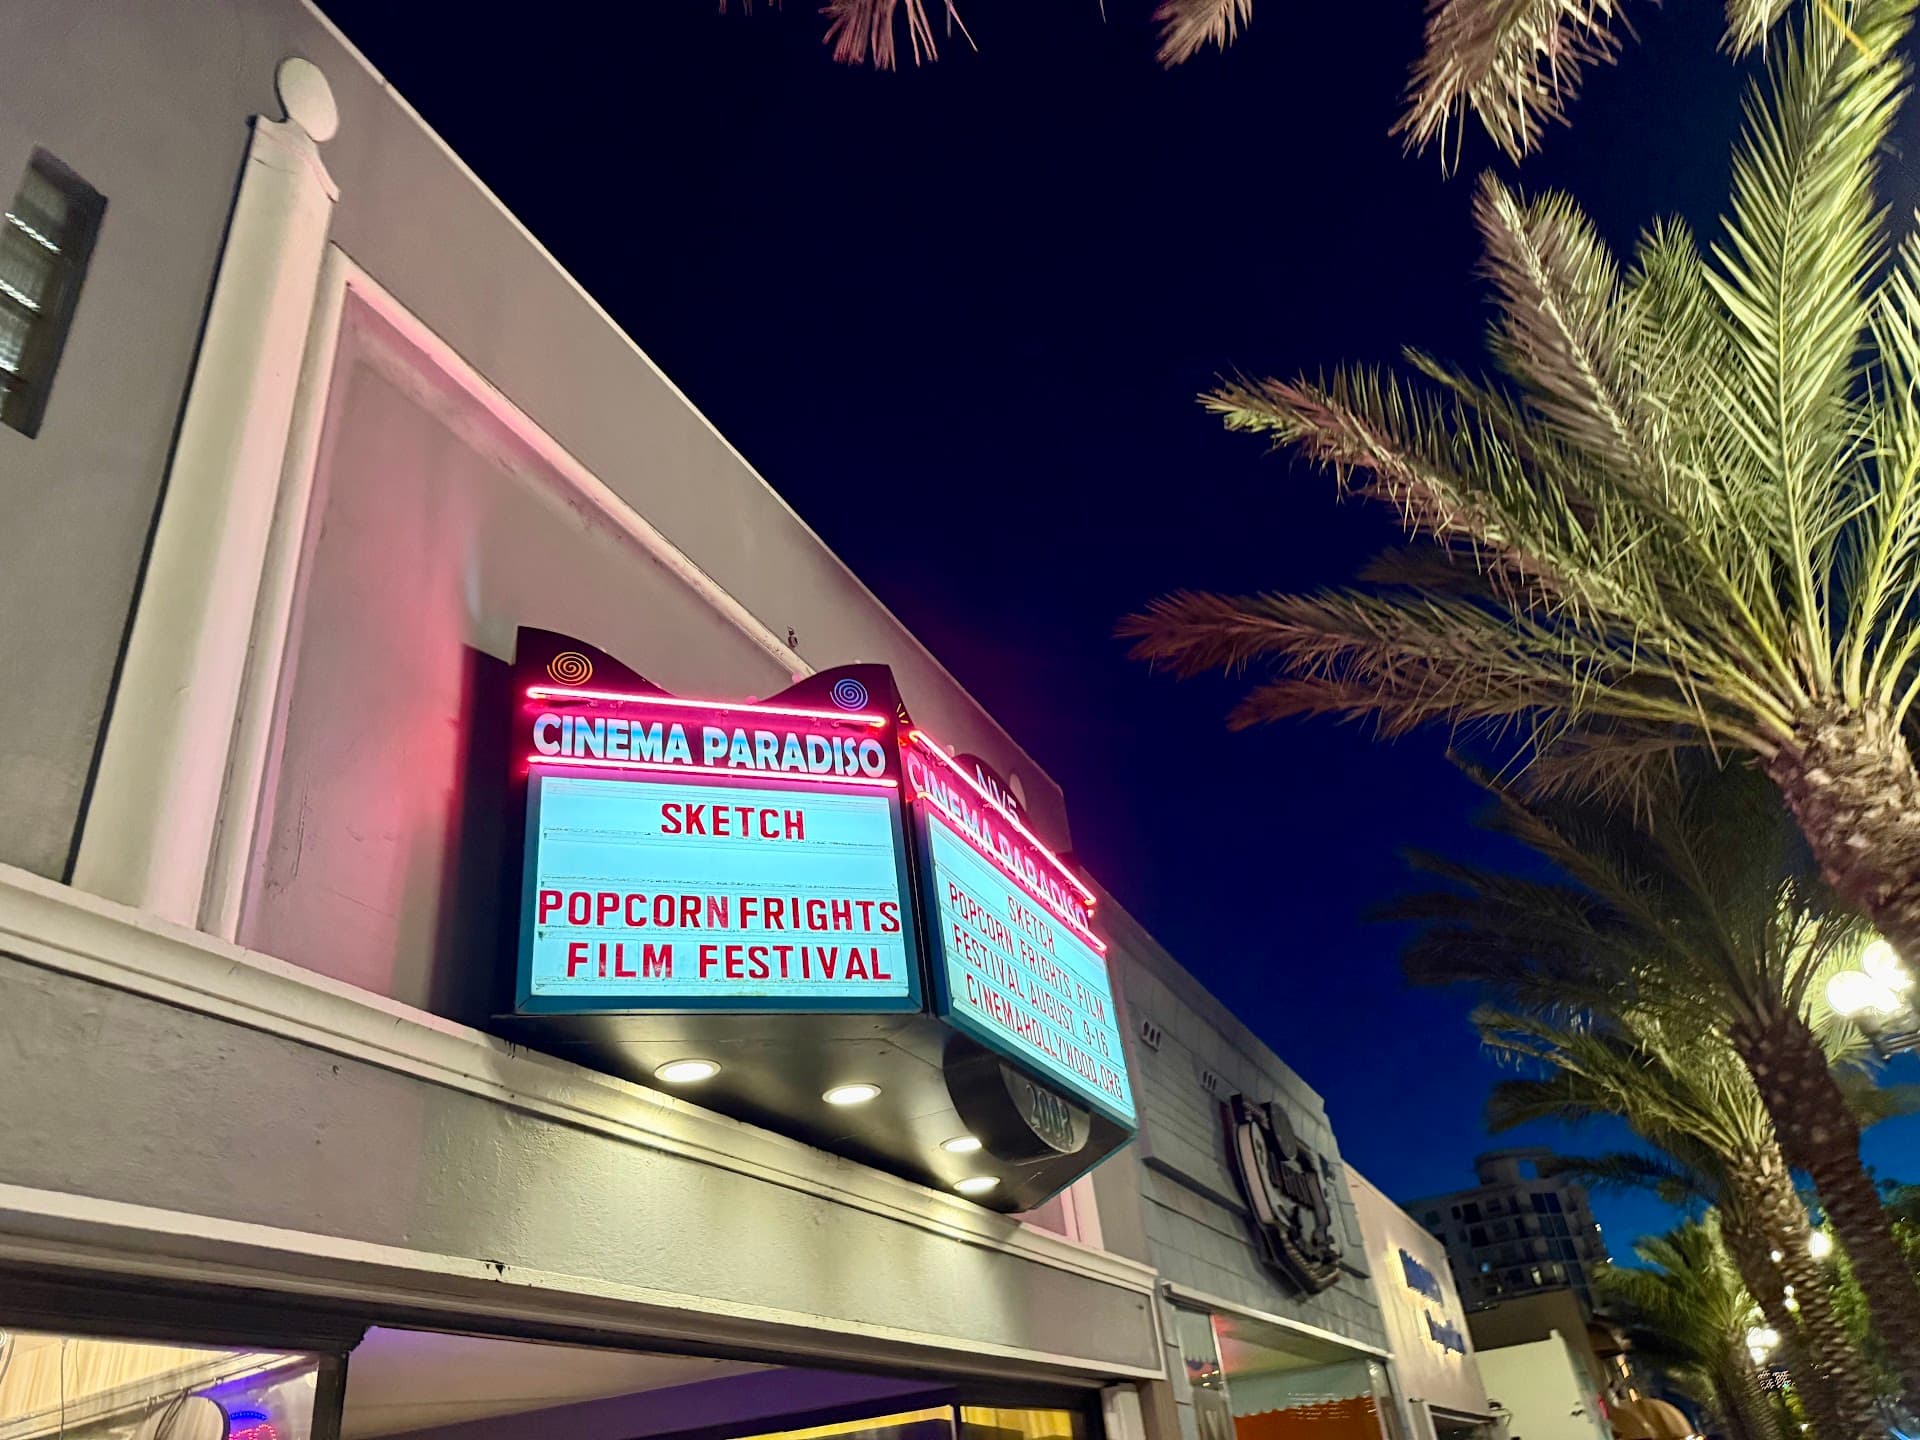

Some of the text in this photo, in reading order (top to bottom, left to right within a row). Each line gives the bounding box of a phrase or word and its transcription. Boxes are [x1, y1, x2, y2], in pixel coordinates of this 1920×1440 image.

[533, 713, 887, 778] CINEMA PARADISO
[660, 802, 805, 841] SKETCH
[907, 751, 1089, 939] CINEMA PARADISO
[538, 889, 901, 933] POPCORN FRIGHTS
[1007, 896, 1056, 955] SKETCH
[566, 942, 892, 981] FILM FESTIVAL
[948, 882, 1106, 1025] POPCORN FRIGHTS FILM
[953, 924, 1109, 1058] FESTIVAL AUGUST 9-16
[966, 973, 1123, 1101] CINEMAHOLLYWOOD.ORG
